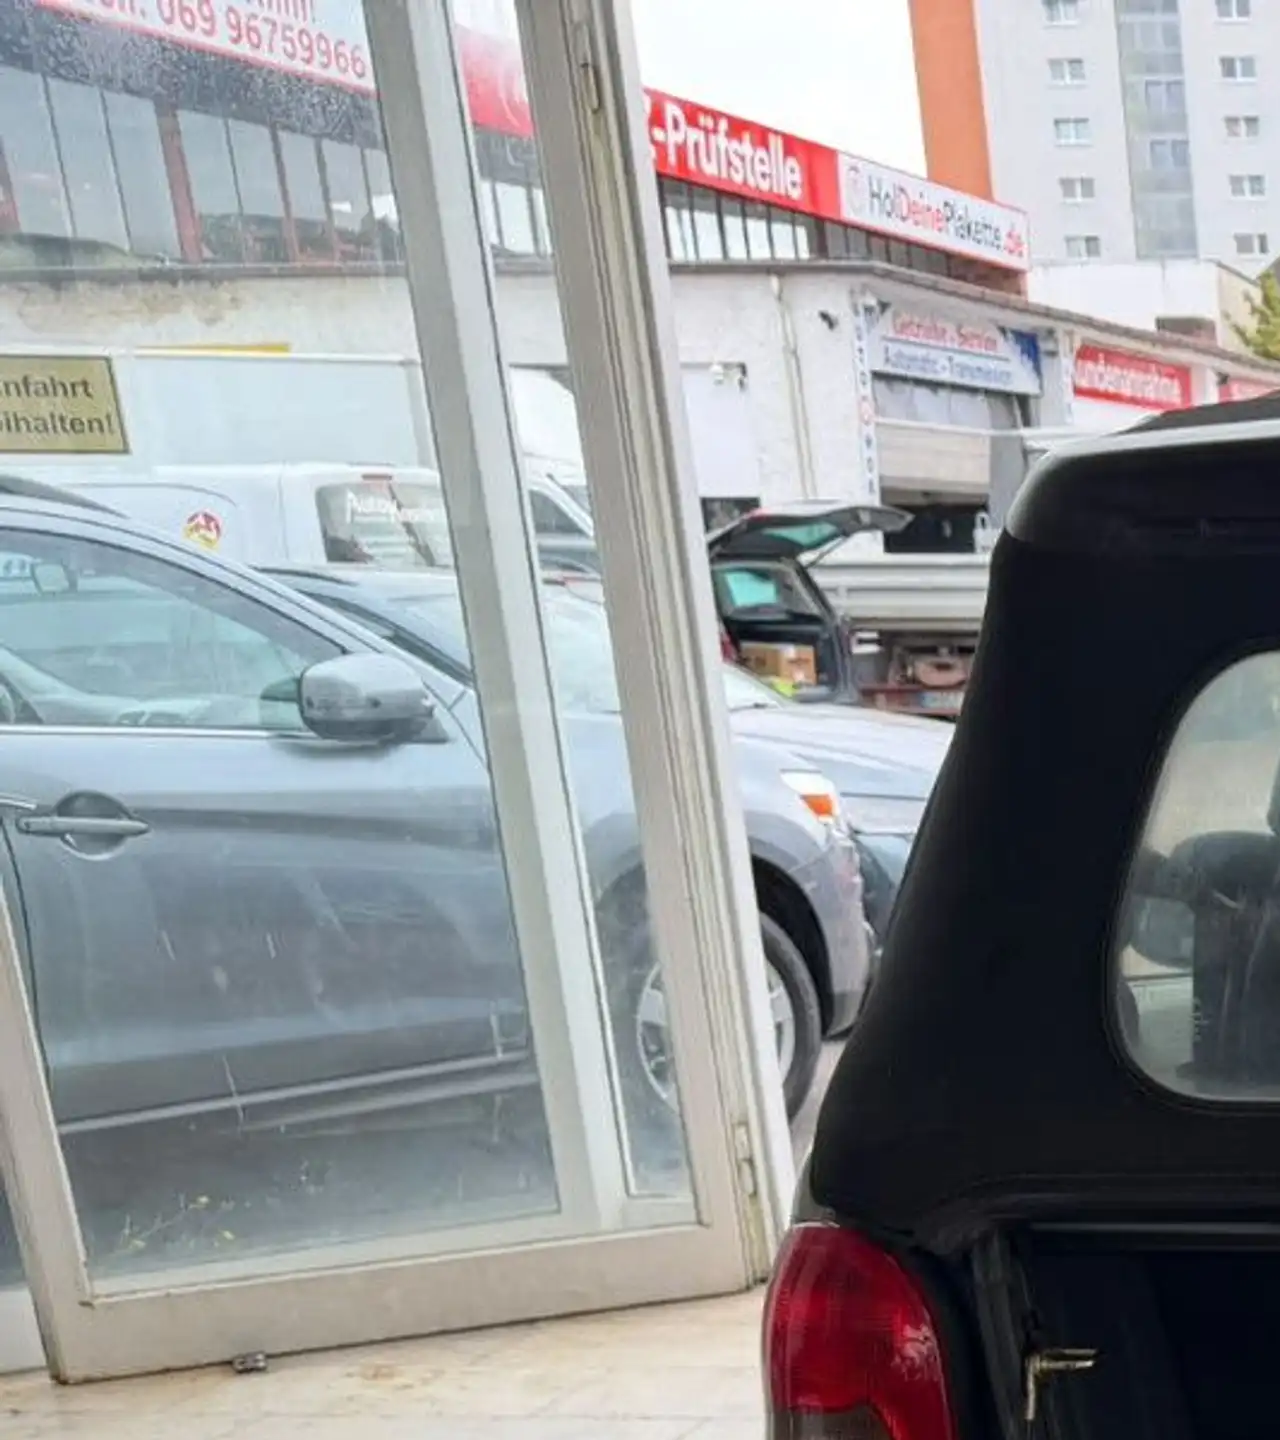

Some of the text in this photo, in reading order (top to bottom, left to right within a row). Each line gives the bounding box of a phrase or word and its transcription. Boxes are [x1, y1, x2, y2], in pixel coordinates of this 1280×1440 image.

[226, 6, 367, 79] 96759966
[644, 95, 802, 201] -Prüfstelle
[0, 411, 114, 435] ihalten!
